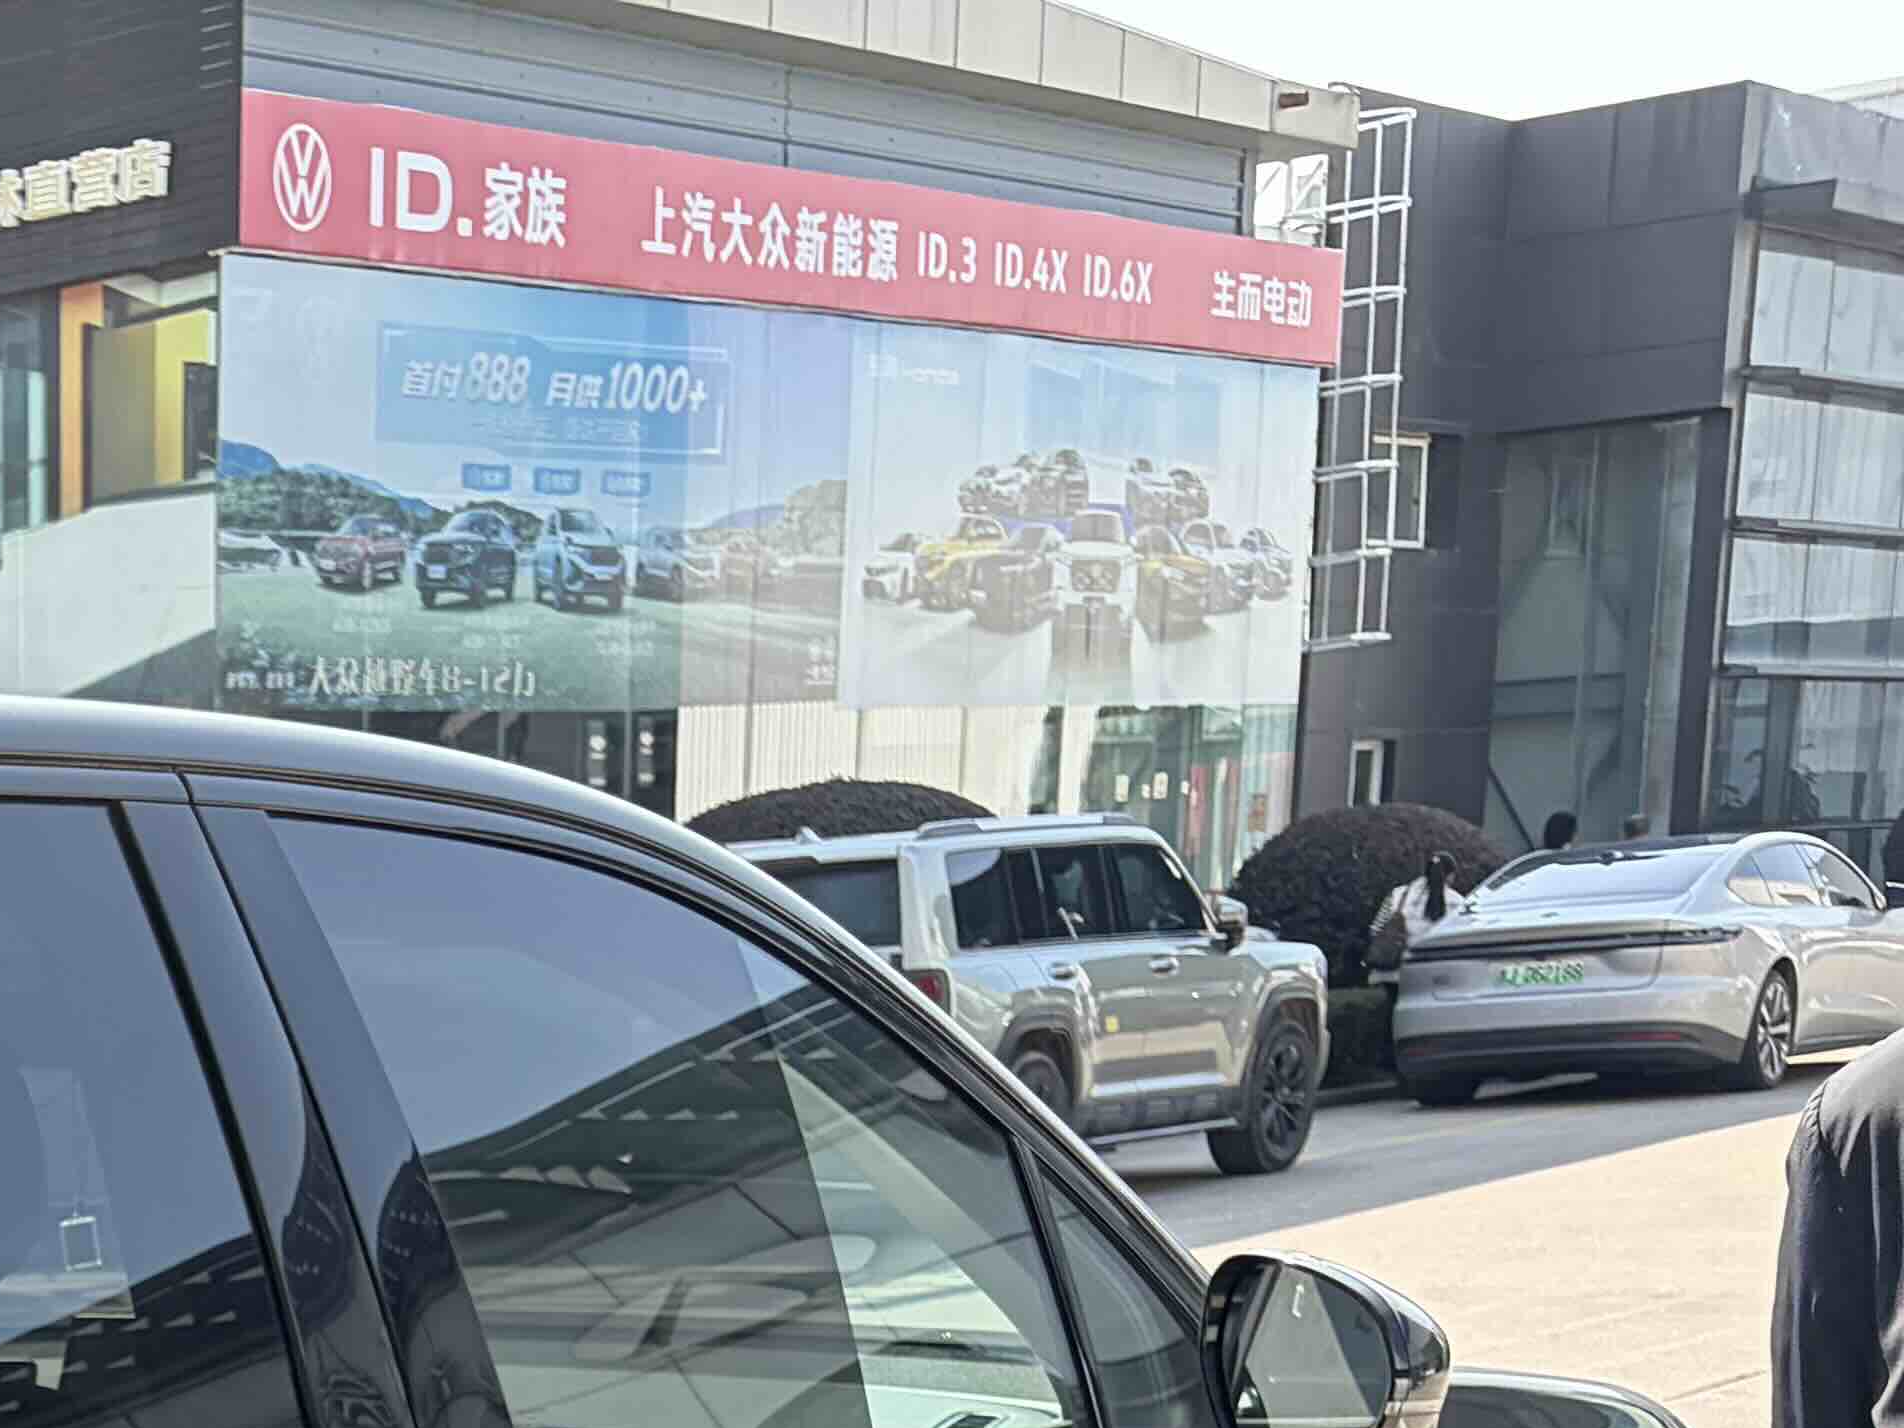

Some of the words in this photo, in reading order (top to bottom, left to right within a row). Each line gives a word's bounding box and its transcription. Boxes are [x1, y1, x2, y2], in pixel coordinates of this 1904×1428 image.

[641, 186, 899, 282] 上汽大众新能源
[917, 230, 976, 284] ID.3
[993, 240, 1069, 297] ID.4X
[1082, 250, 1152, 305] ID.6X
[1210, 269, 1313, 328] 生而电动
